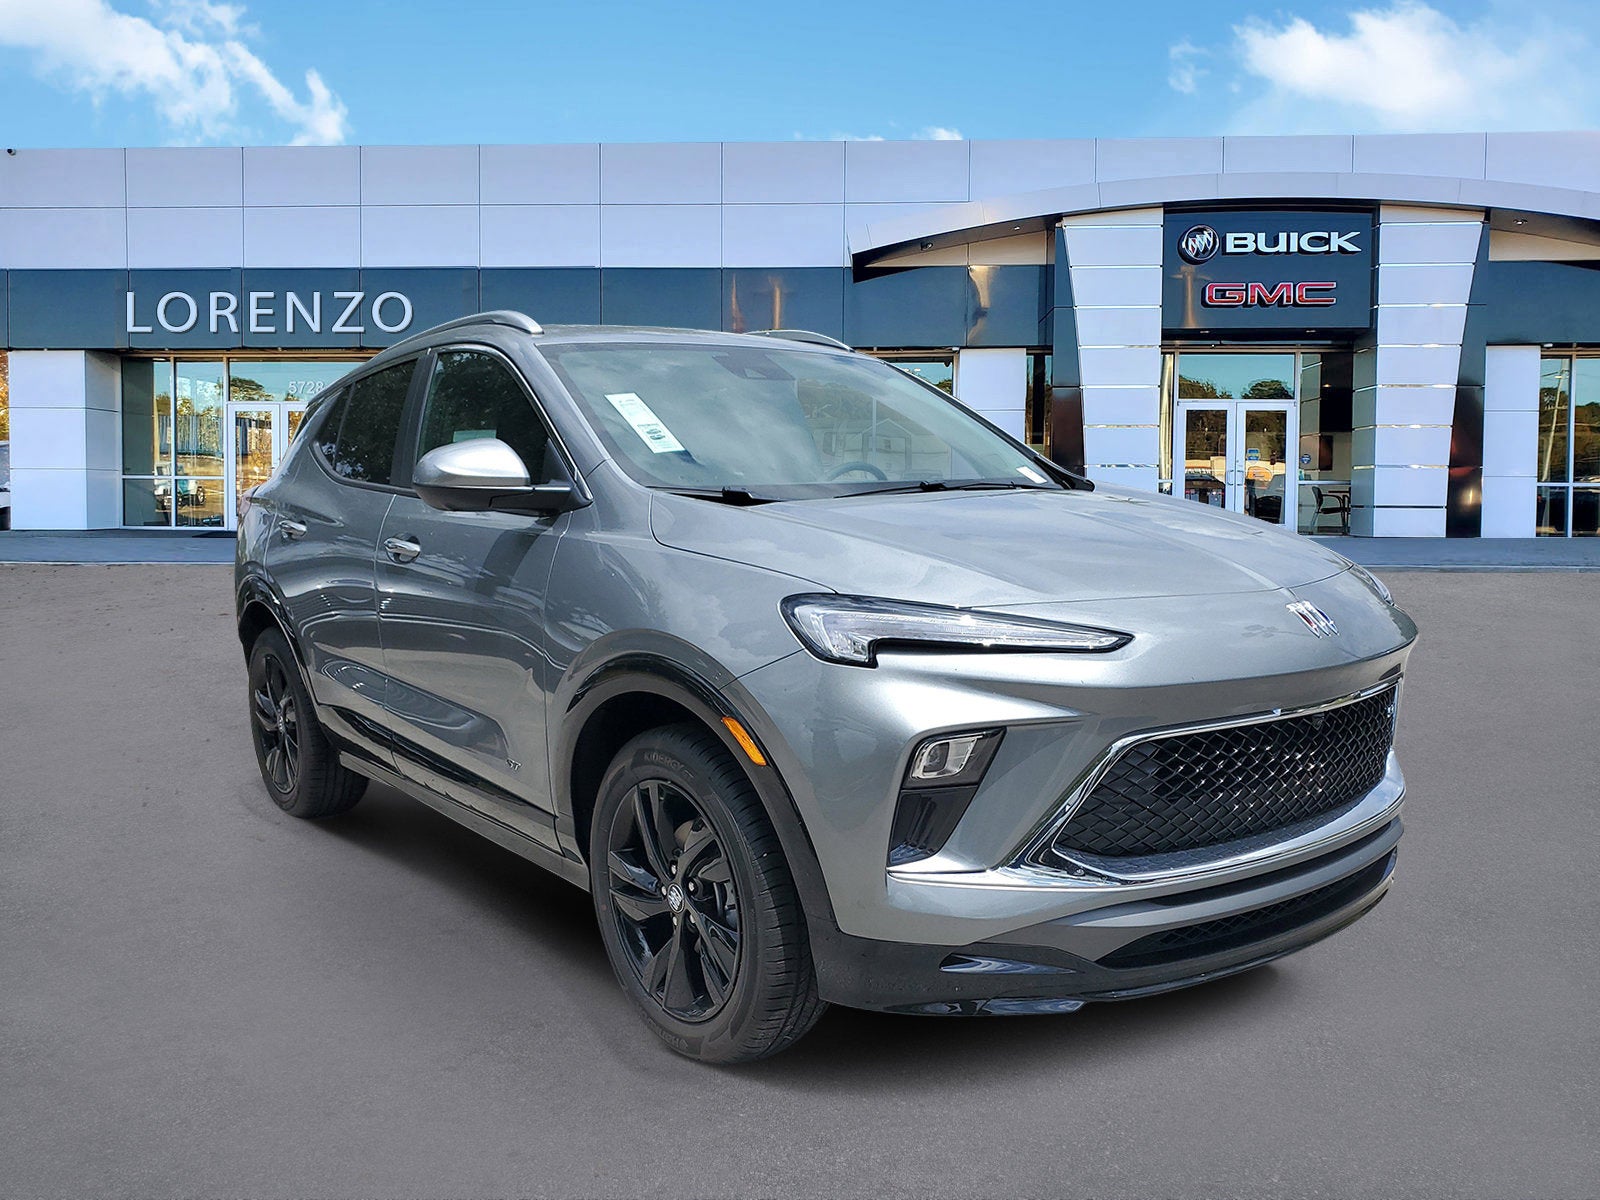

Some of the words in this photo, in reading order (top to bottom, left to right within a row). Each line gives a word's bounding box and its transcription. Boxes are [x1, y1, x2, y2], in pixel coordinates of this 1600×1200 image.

[1225, 231, 1362, 253] BUICK
[1206, 281, 1337, 305] GMC
[126, 291, 414, 333] LORENZO
[288, 380, 325, 394] 5728
